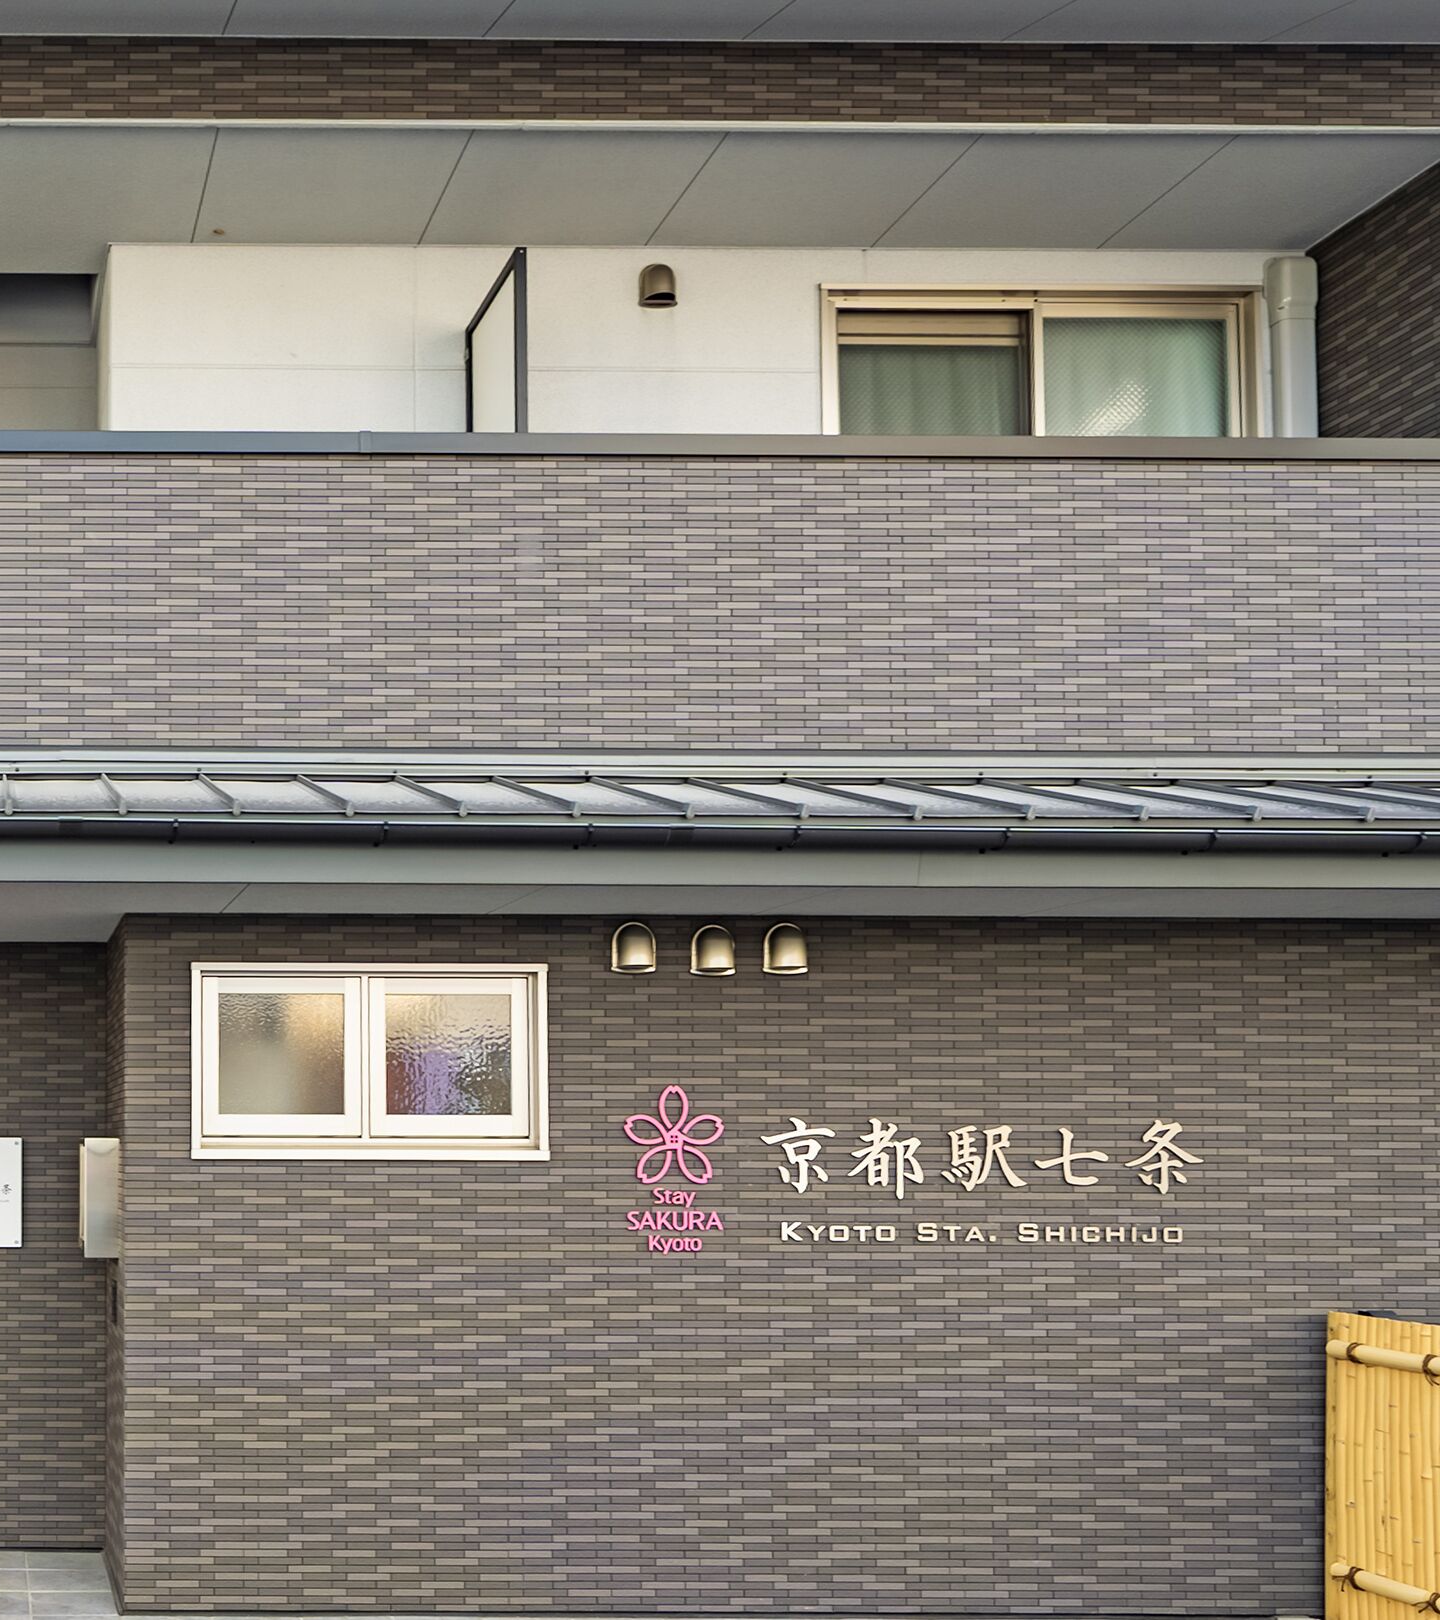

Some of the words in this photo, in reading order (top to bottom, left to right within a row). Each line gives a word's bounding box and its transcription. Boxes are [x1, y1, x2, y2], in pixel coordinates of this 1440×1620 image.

[760, 1118, 1204, 1200] 京都駅七条
[653, 1187, 696, 1208] Stay
[626, 1210, 724, 1231] SAKURA
[648, 1235, 703, 1255] Kyoto
